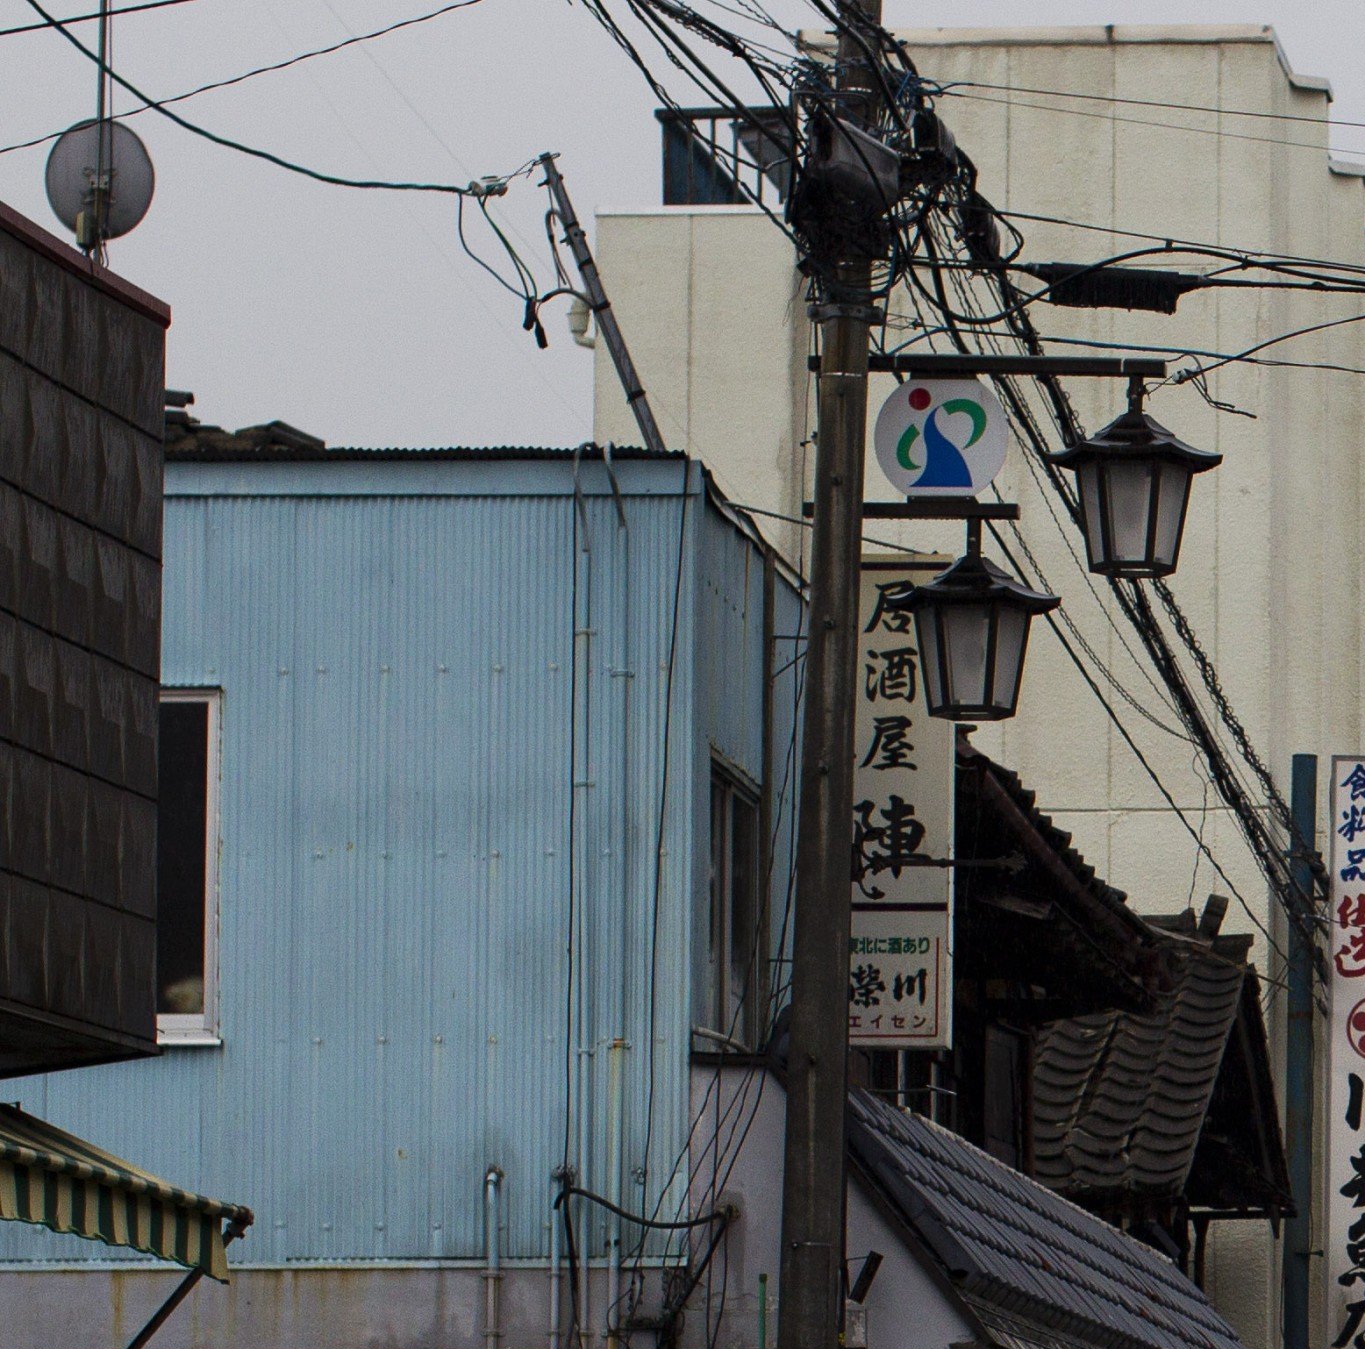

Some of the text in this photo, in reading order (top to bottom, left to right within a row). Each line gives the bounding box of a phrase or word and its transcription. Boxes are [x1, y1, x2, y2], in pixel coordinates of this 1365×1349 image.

[860, 579, 918, 771] 居酒屋
[849, 1014, 926, 1029] エイセン
